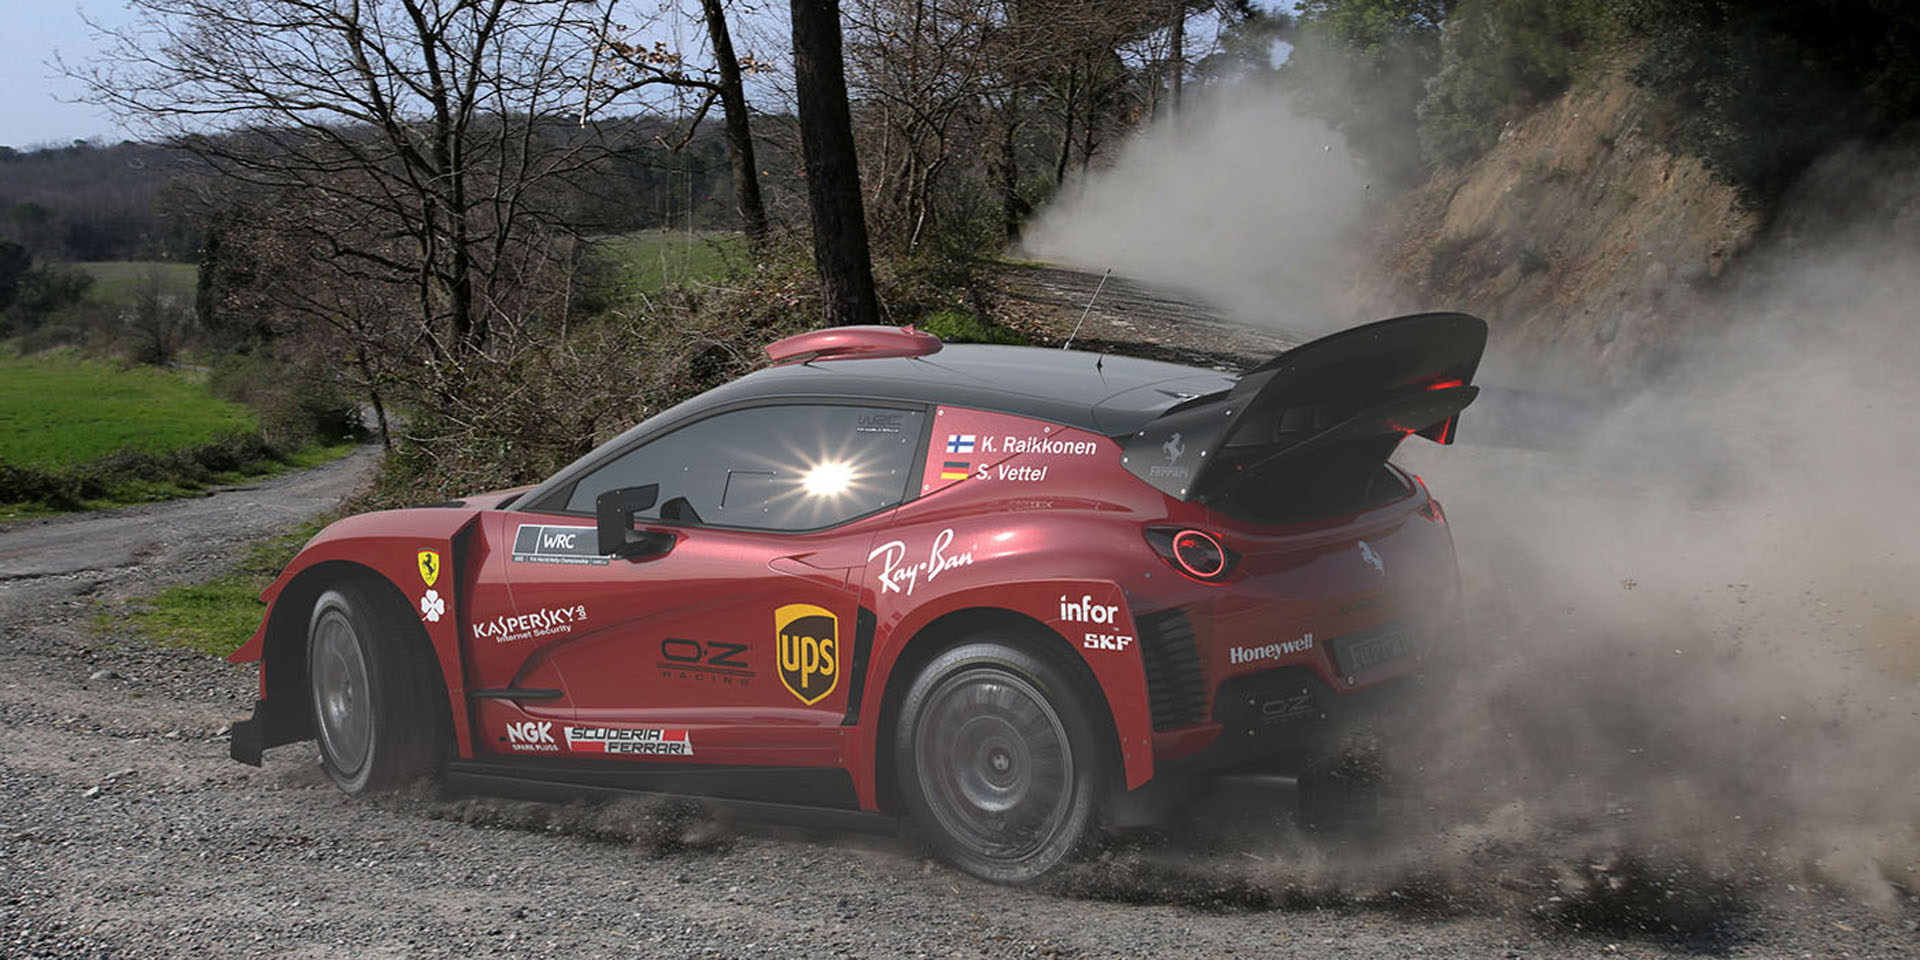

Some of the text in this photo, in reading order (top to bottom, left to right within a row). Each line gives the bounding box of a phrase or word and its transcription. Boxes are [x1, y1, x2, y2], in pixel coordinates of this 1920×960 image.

[981, 436, 1097, 455] K. Raikkonen
[976, 463, 1048, 481] S. Vettel
[543, 533, 577, 549] WRC
[1060, 594, 1119, 624] infor
[496, 624, 572, 643] Internet Security
[1083, 633, 1133, 651] SKF
[1229, 633, 1313, 664] Honeywell
[505, 721, 555, 743] NGK
[570, 727, 661, 741] SCUDERIA
[607, 742, 686, 754] FERRARI
